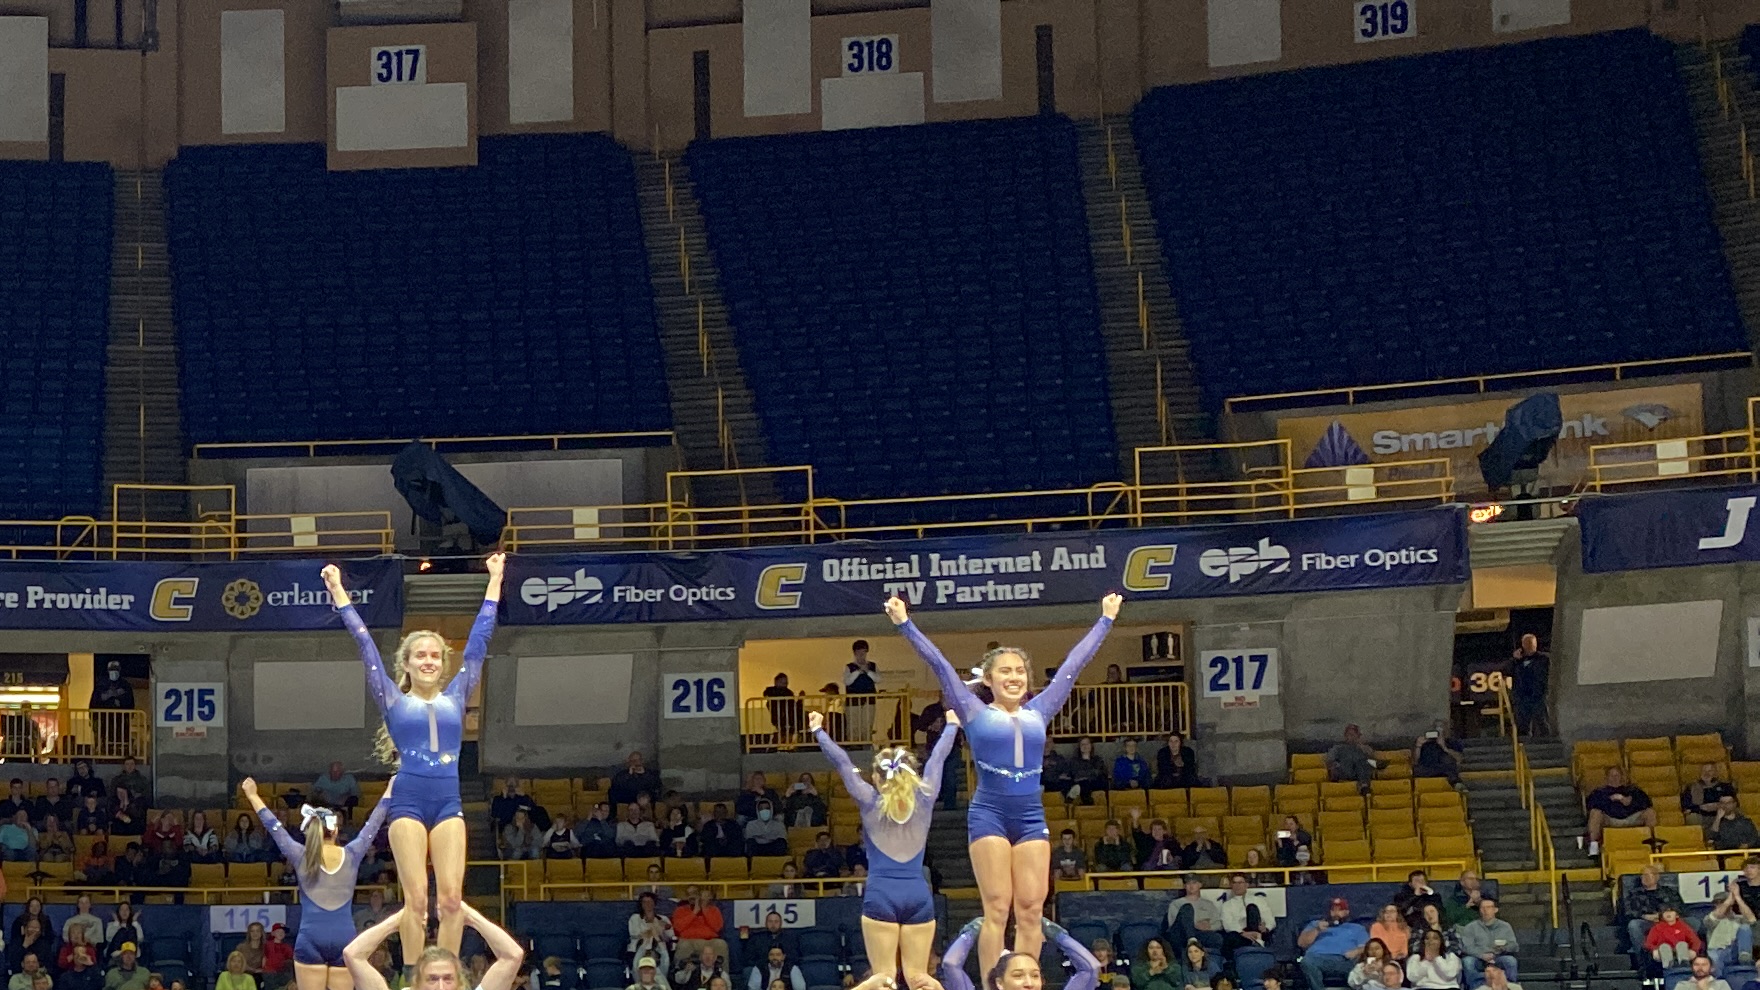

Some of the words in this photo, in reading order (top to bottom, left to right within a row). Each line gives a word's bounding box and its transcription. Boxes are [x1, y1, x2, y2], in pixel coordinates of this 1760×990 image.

[1360, 0, 1408, 38] 319
[377, 49, 420, 82] 317
[848, 38, 893, 72] 318
[1372, 414, 1610, 455] Smartnk
[1698, 496, 1758, 550] J
[822, 554, 921, 583] Official
[929, 550, 1042, 577] Internet
[1050, 545, 1106, 571] And
[1122, 544, 1178, 592] C
[1200, 537, 1291, 583] epb
[1301, 552, 1359, 571] Fiber
[1364, 546, 1439, 571] Optics
[26, 586, 135, 611] Provider
[150, 577, 199, 622] C
[267, 582, 374, 611] erlaner
[520, 568, 604, 613] epb
[613, 585, 664, 604] Fiber
[669, 584, 736, 606] Optics
[755, 563, 808, 610] C
[884, 581, 925, 606] TV
[935, 581, 1045, 605] Partner
[4, 672, 24, 685] 215
[1209, 654, 1269, 691] 217
[164, 688, 215, 722] 215
[672, 678, 726, 713] 216
[224, 908, 271, 929] 115
